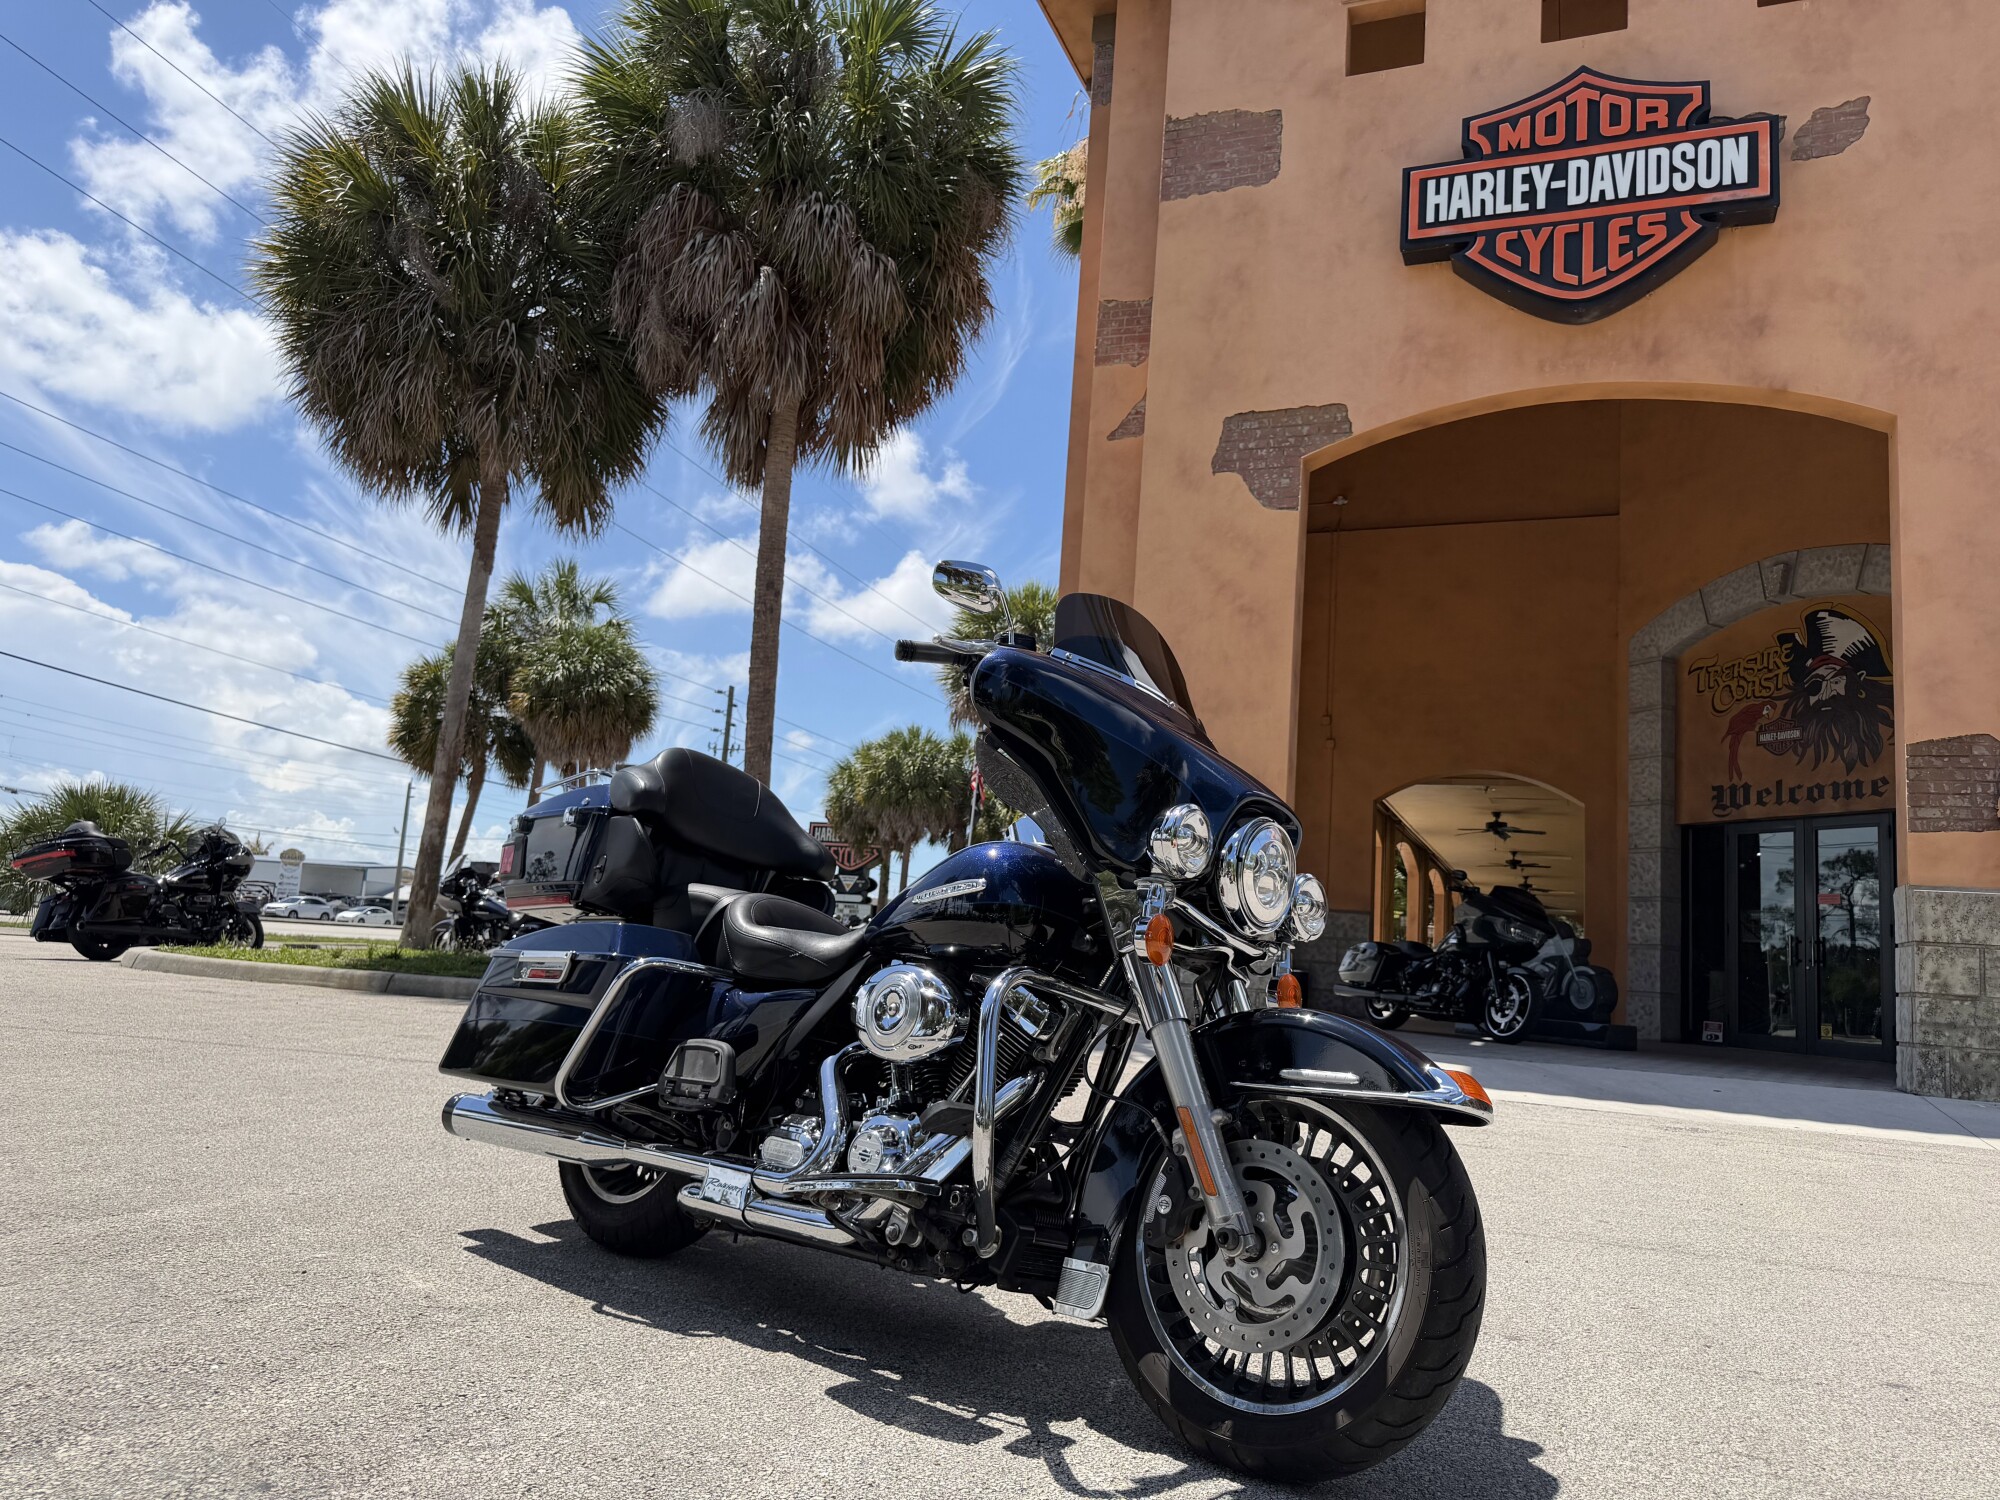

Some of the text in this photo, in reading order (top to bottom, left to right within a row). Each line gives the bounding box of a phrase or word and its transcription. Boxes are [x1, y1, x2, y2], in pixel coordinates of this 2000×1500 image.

[1498, 87, 1669, 152] MOTOR
[1425, 136, 1750, 224] HARLEY-DAVIDSON
[1495, 211, 1668, 286] CYCLES
[1759, 729, 1801, 742] HARLEY-DAVIDSON
[1711, 775, 1890, 818] Welcome
[831, 847, 871, 866] CYCLS
